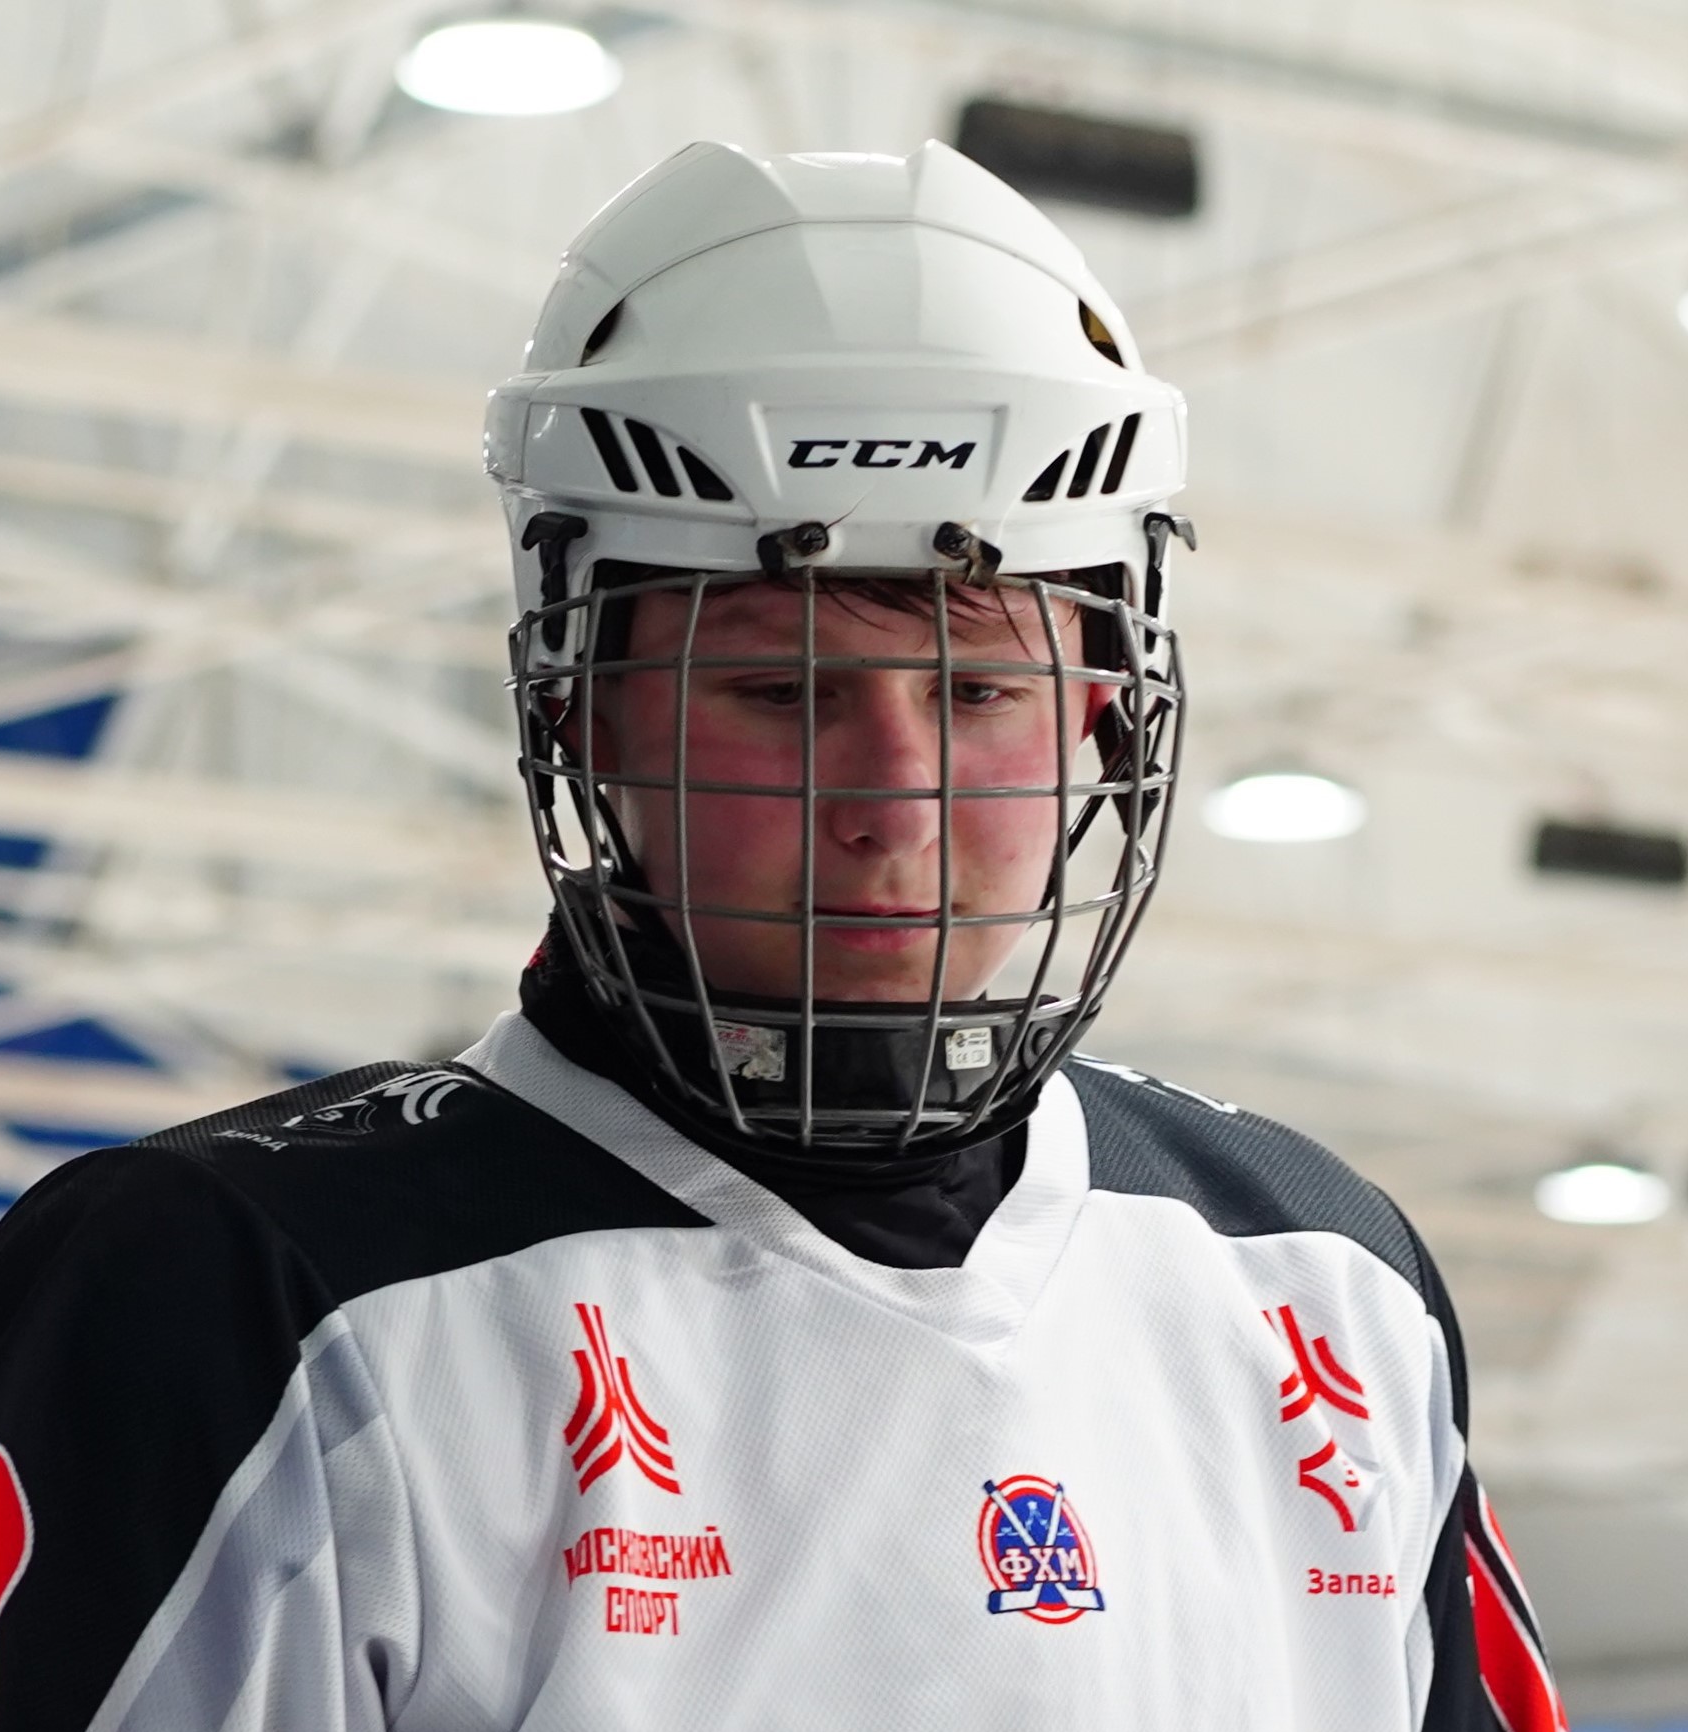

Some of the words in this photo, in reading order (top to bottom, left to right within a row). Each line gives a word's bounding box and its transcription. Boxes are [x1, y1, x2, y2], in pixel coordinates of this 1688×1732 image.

[787, 440, 977, 469] CCM
[999, 1546, 1087, 1583] ФХМ
[606, 1586, 679, 1636] СПОРТ
